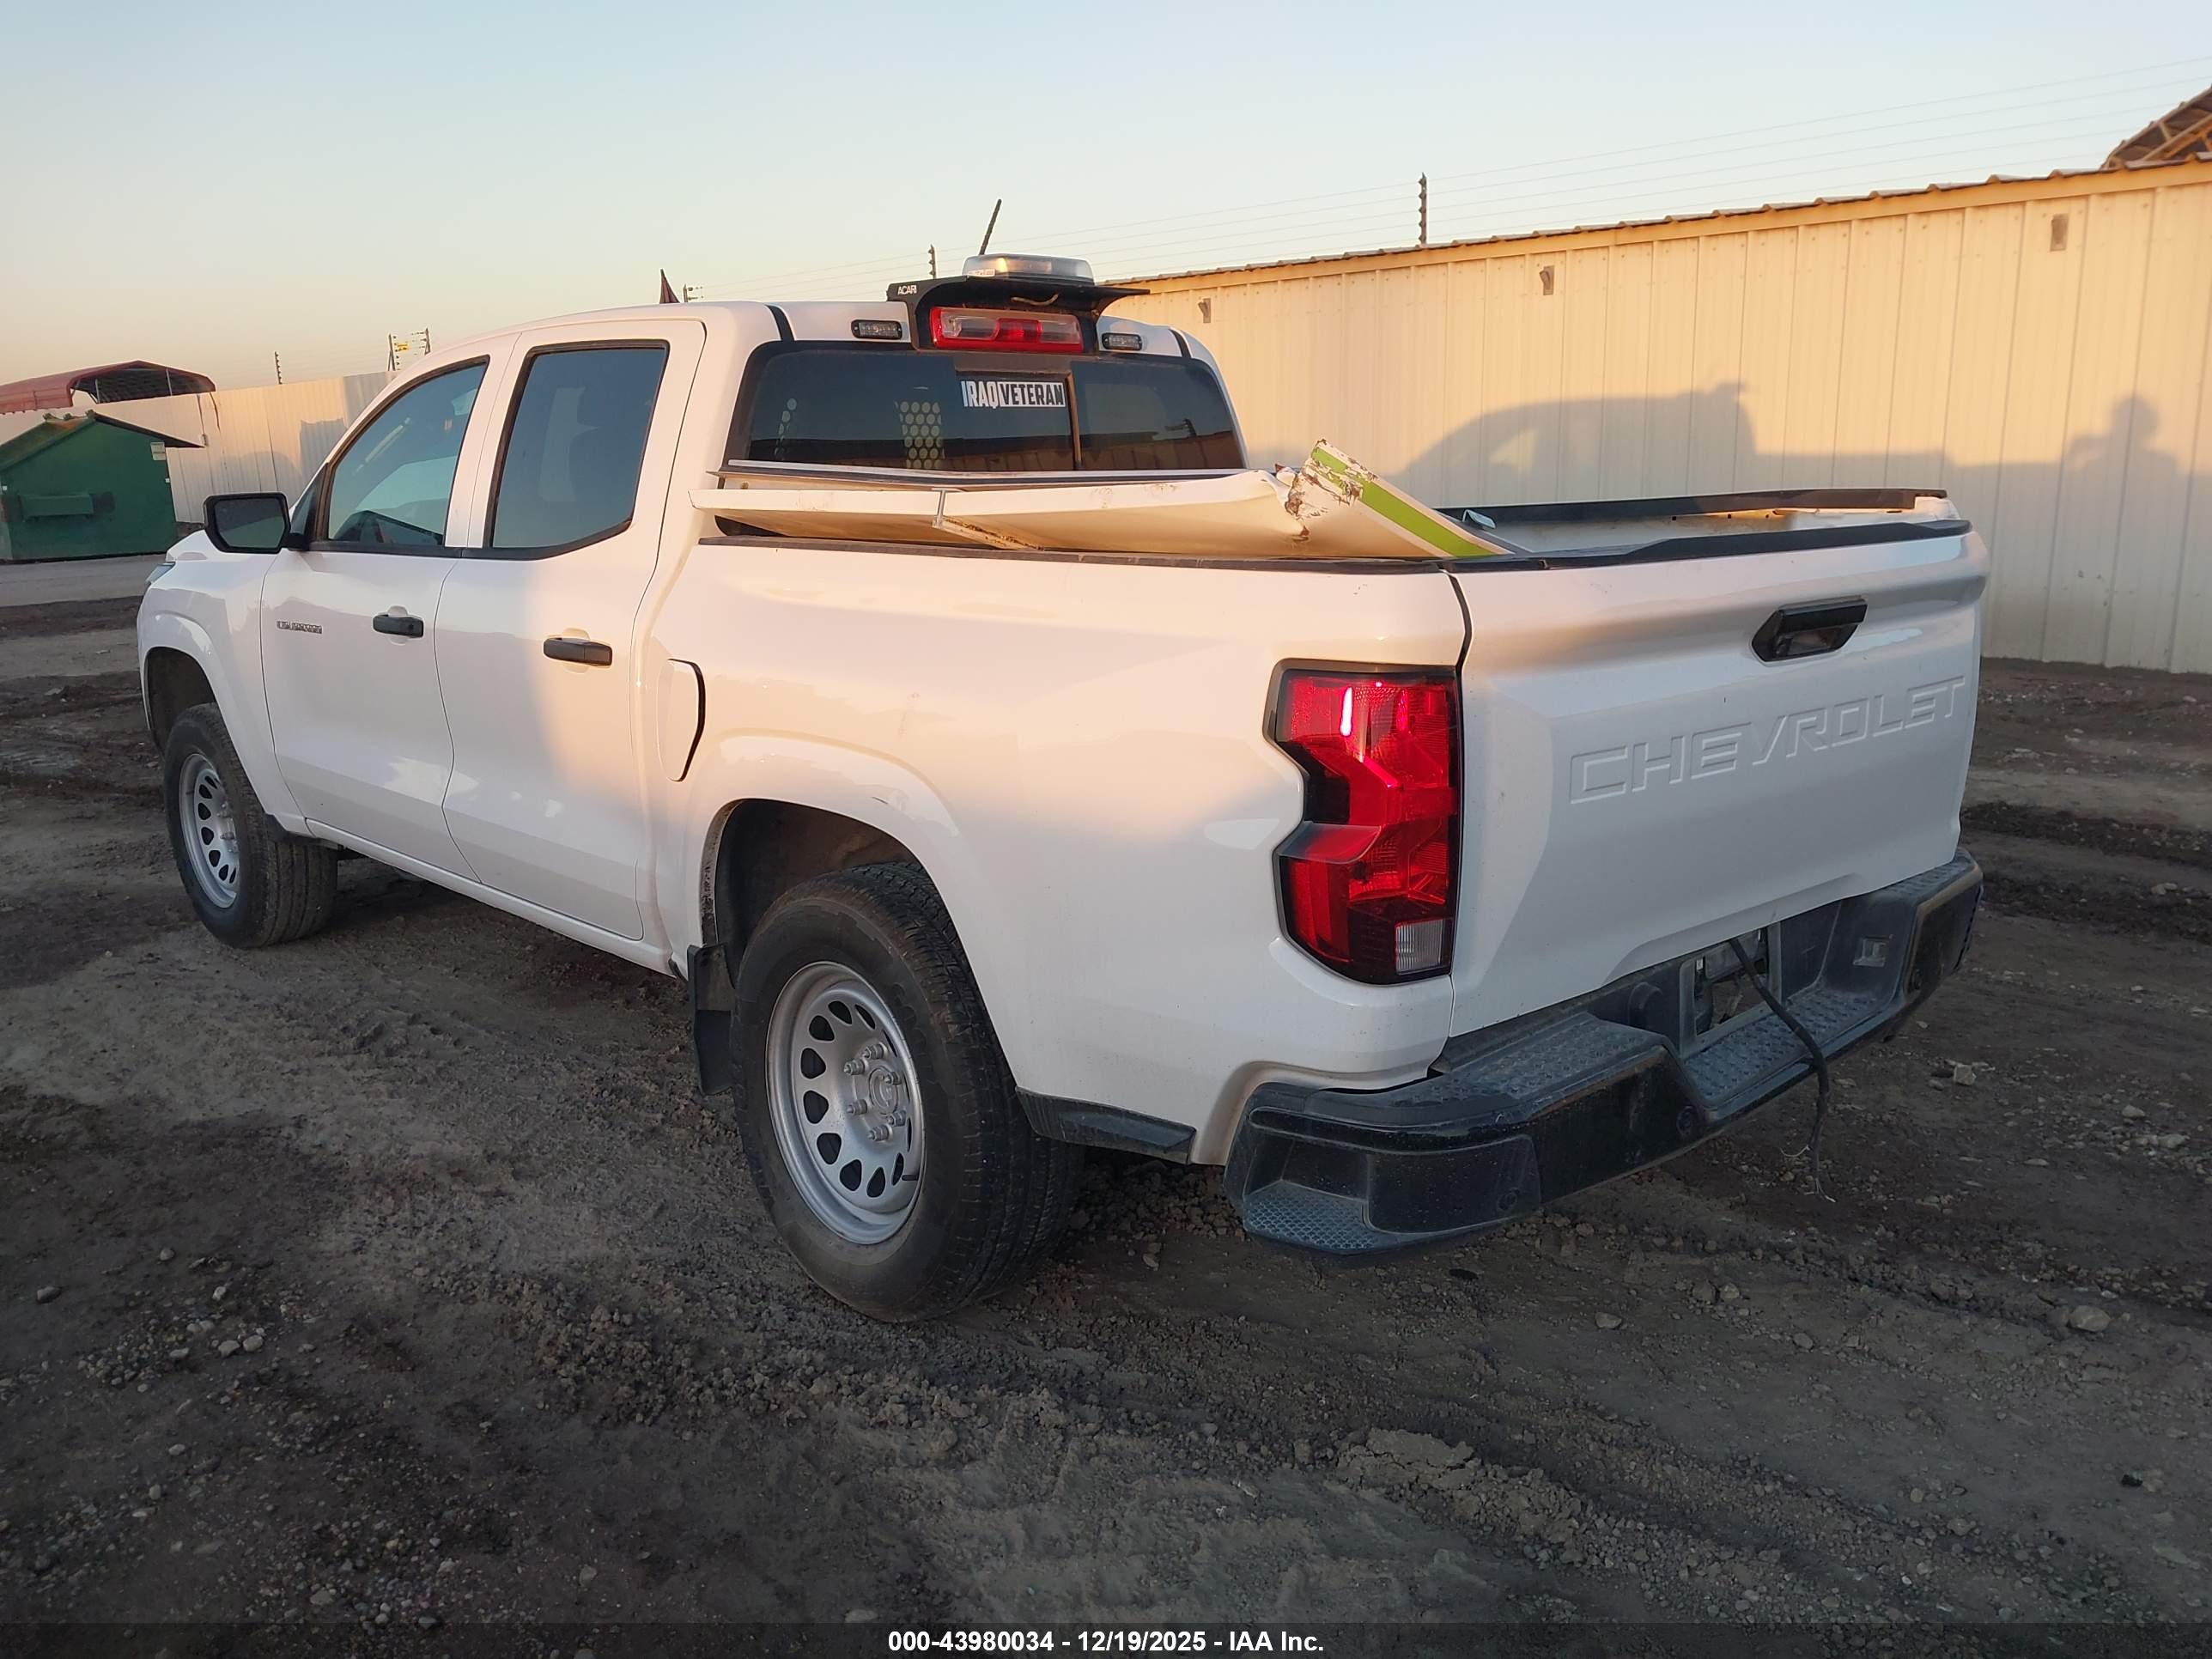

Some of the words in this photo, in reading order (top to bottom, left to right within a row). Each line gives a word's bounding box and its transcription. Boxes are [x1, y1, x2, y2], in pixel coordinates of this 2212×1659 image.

[960, 380, 999, 410] IRAQ
[999, 383, 1065, 406] VETERAN
[1570, 675, 1966, 805] CHEVROLET
